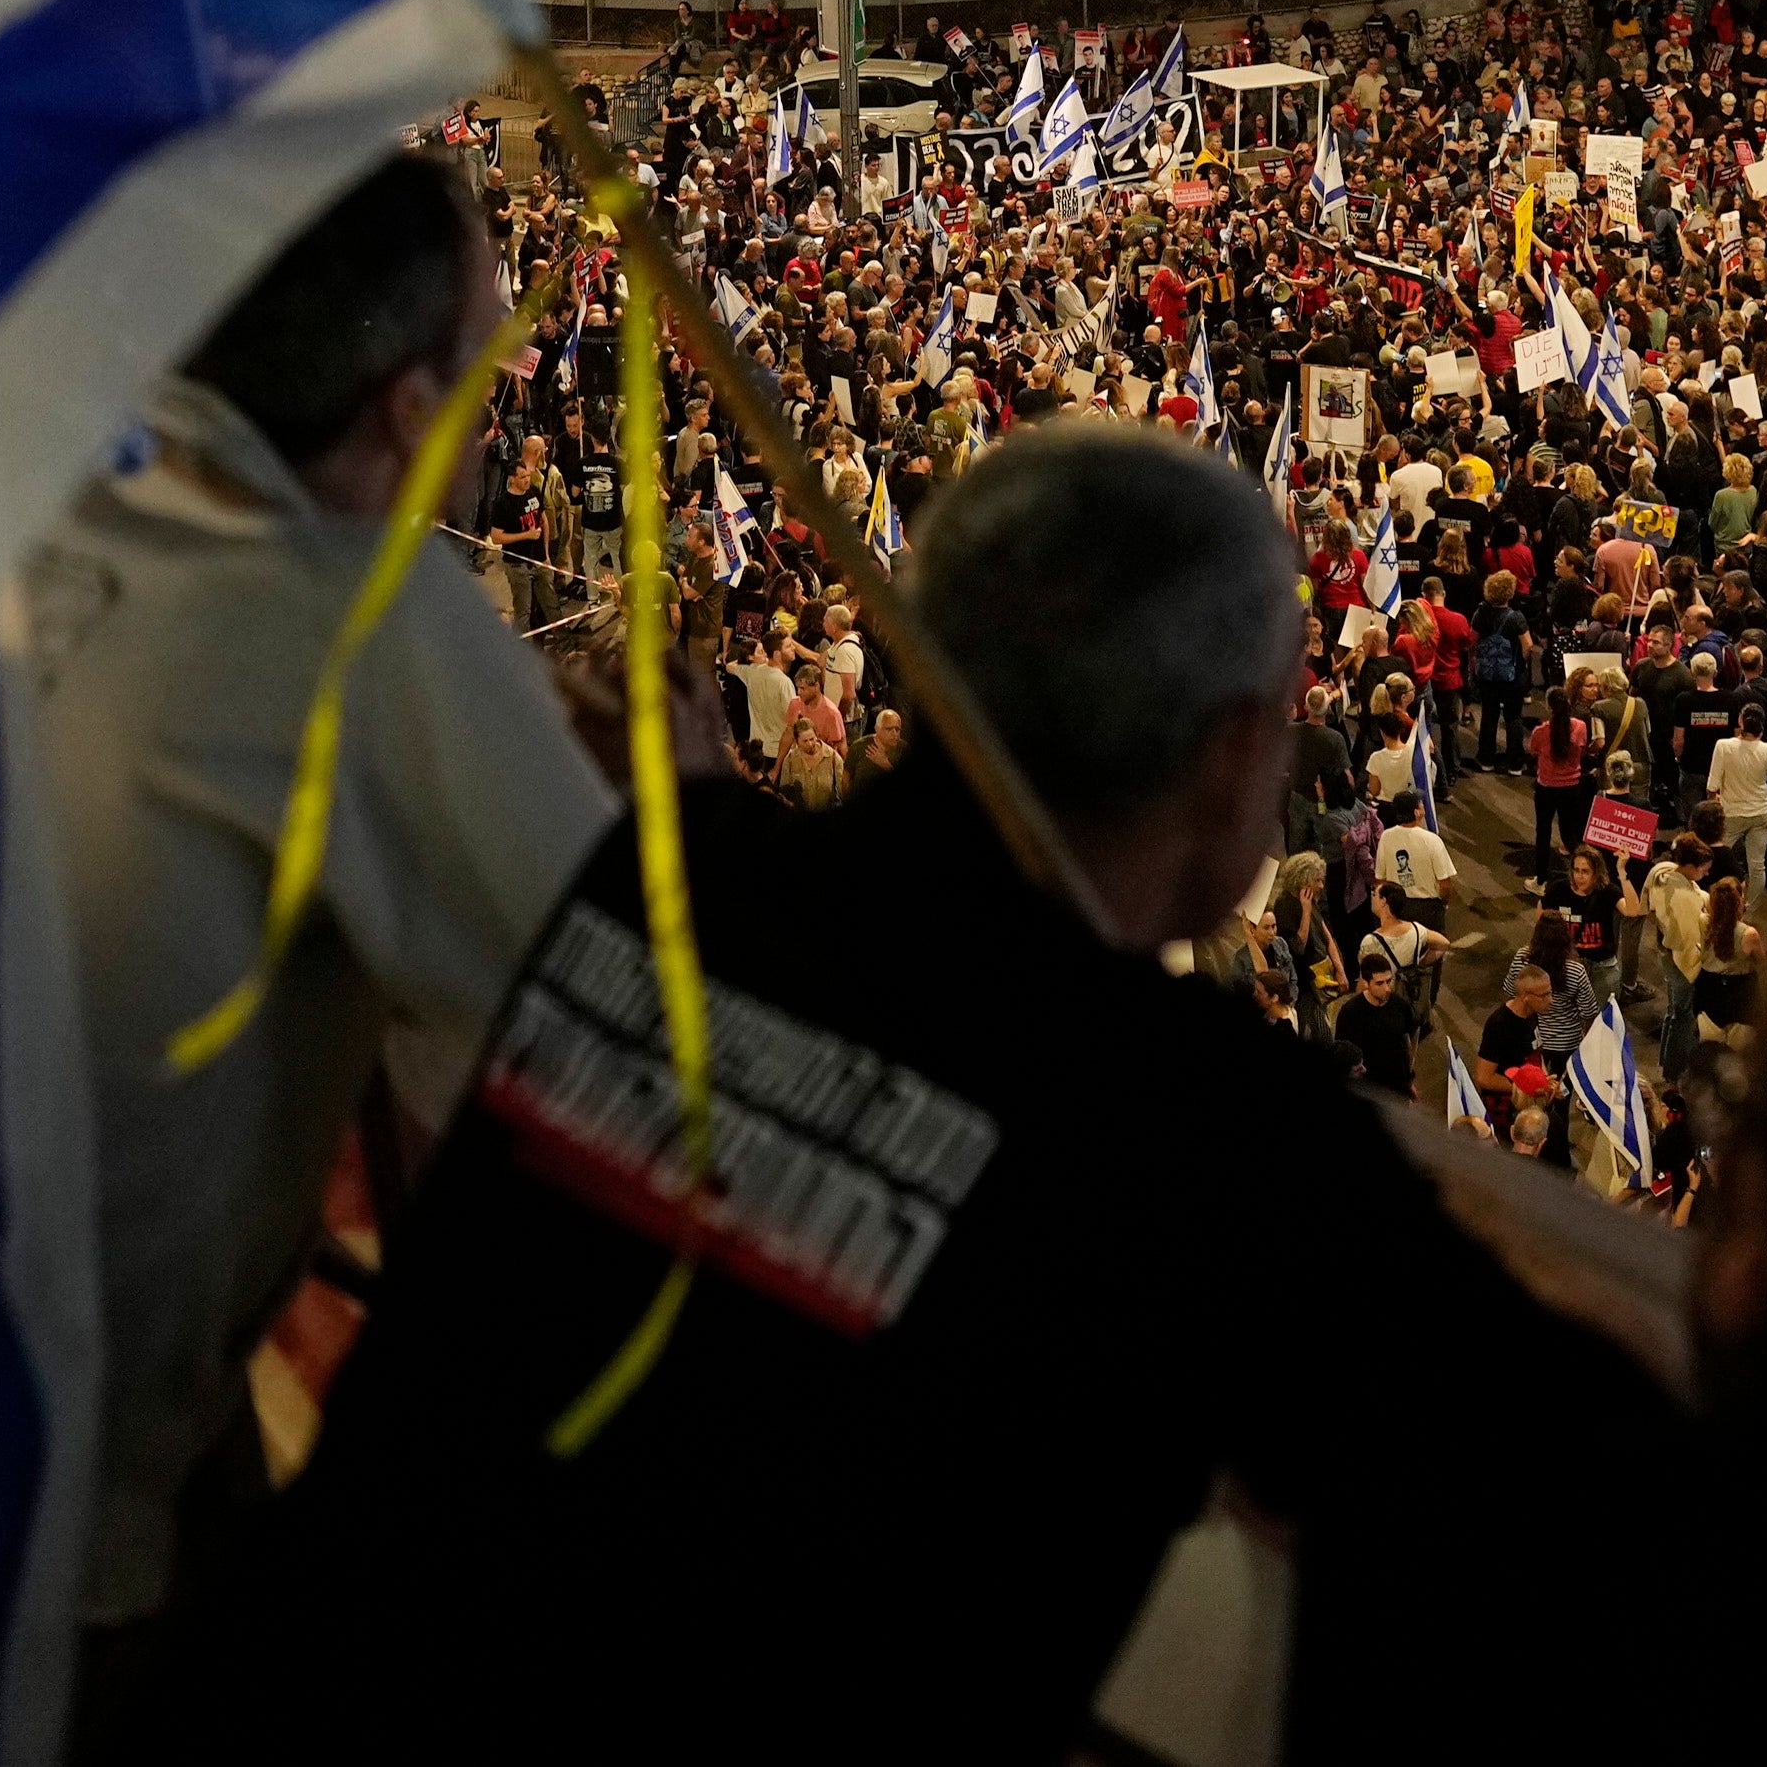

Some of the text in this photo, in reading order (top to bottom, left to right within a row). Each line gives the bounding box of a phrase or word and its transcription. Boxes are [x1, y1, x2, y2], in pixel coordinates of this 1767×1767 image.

[1610, 160, 1632, 176] ממשלה
[1055, 187, 1077, 200] SAVE
[1056, 197, 1078, 210] THEM
[1521, 333, 1553, 359] DIE
[1590, 817, 1652, 843] נשים דורשות
